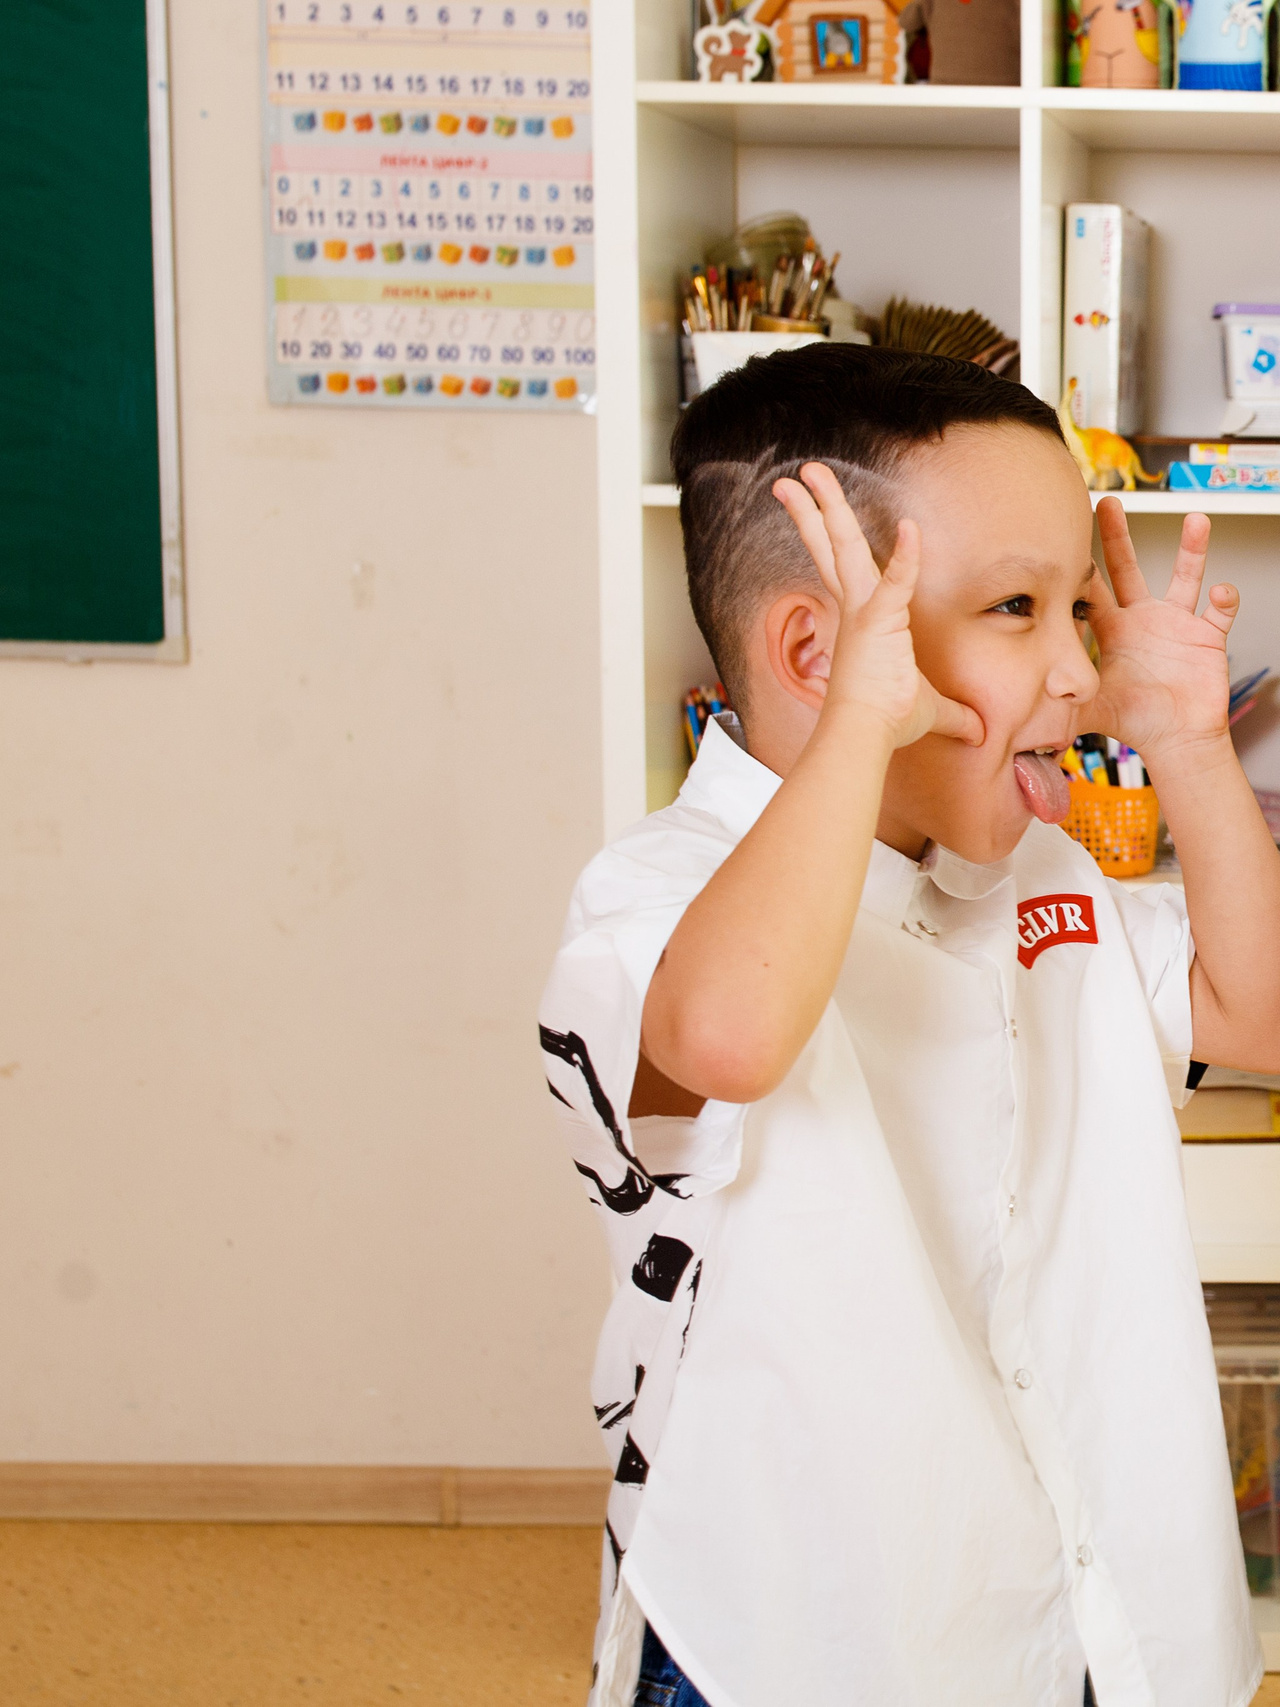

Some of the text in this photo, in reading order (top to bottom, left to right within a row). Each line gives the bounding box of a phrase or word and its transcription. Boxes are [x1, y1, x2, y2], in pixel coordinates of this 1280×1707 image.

[277, 3, 588, 29] 1 2 3 4 5 6 7 8 9 10
[275, 71, 591, 98] 11 12 13 14 15 16 17 18 19 20
[276, 175, 594, 204] 0 1 2 3 4 5 6 7 8 9 10
[277, 207, 594, 235] 10 11 12 13 14 15 16 17 18 19 20
[280, 340, 596, 365] 10 20 30 40 50 60 70 80 90 100
[1018, 903, 1090, 949] GLVR
